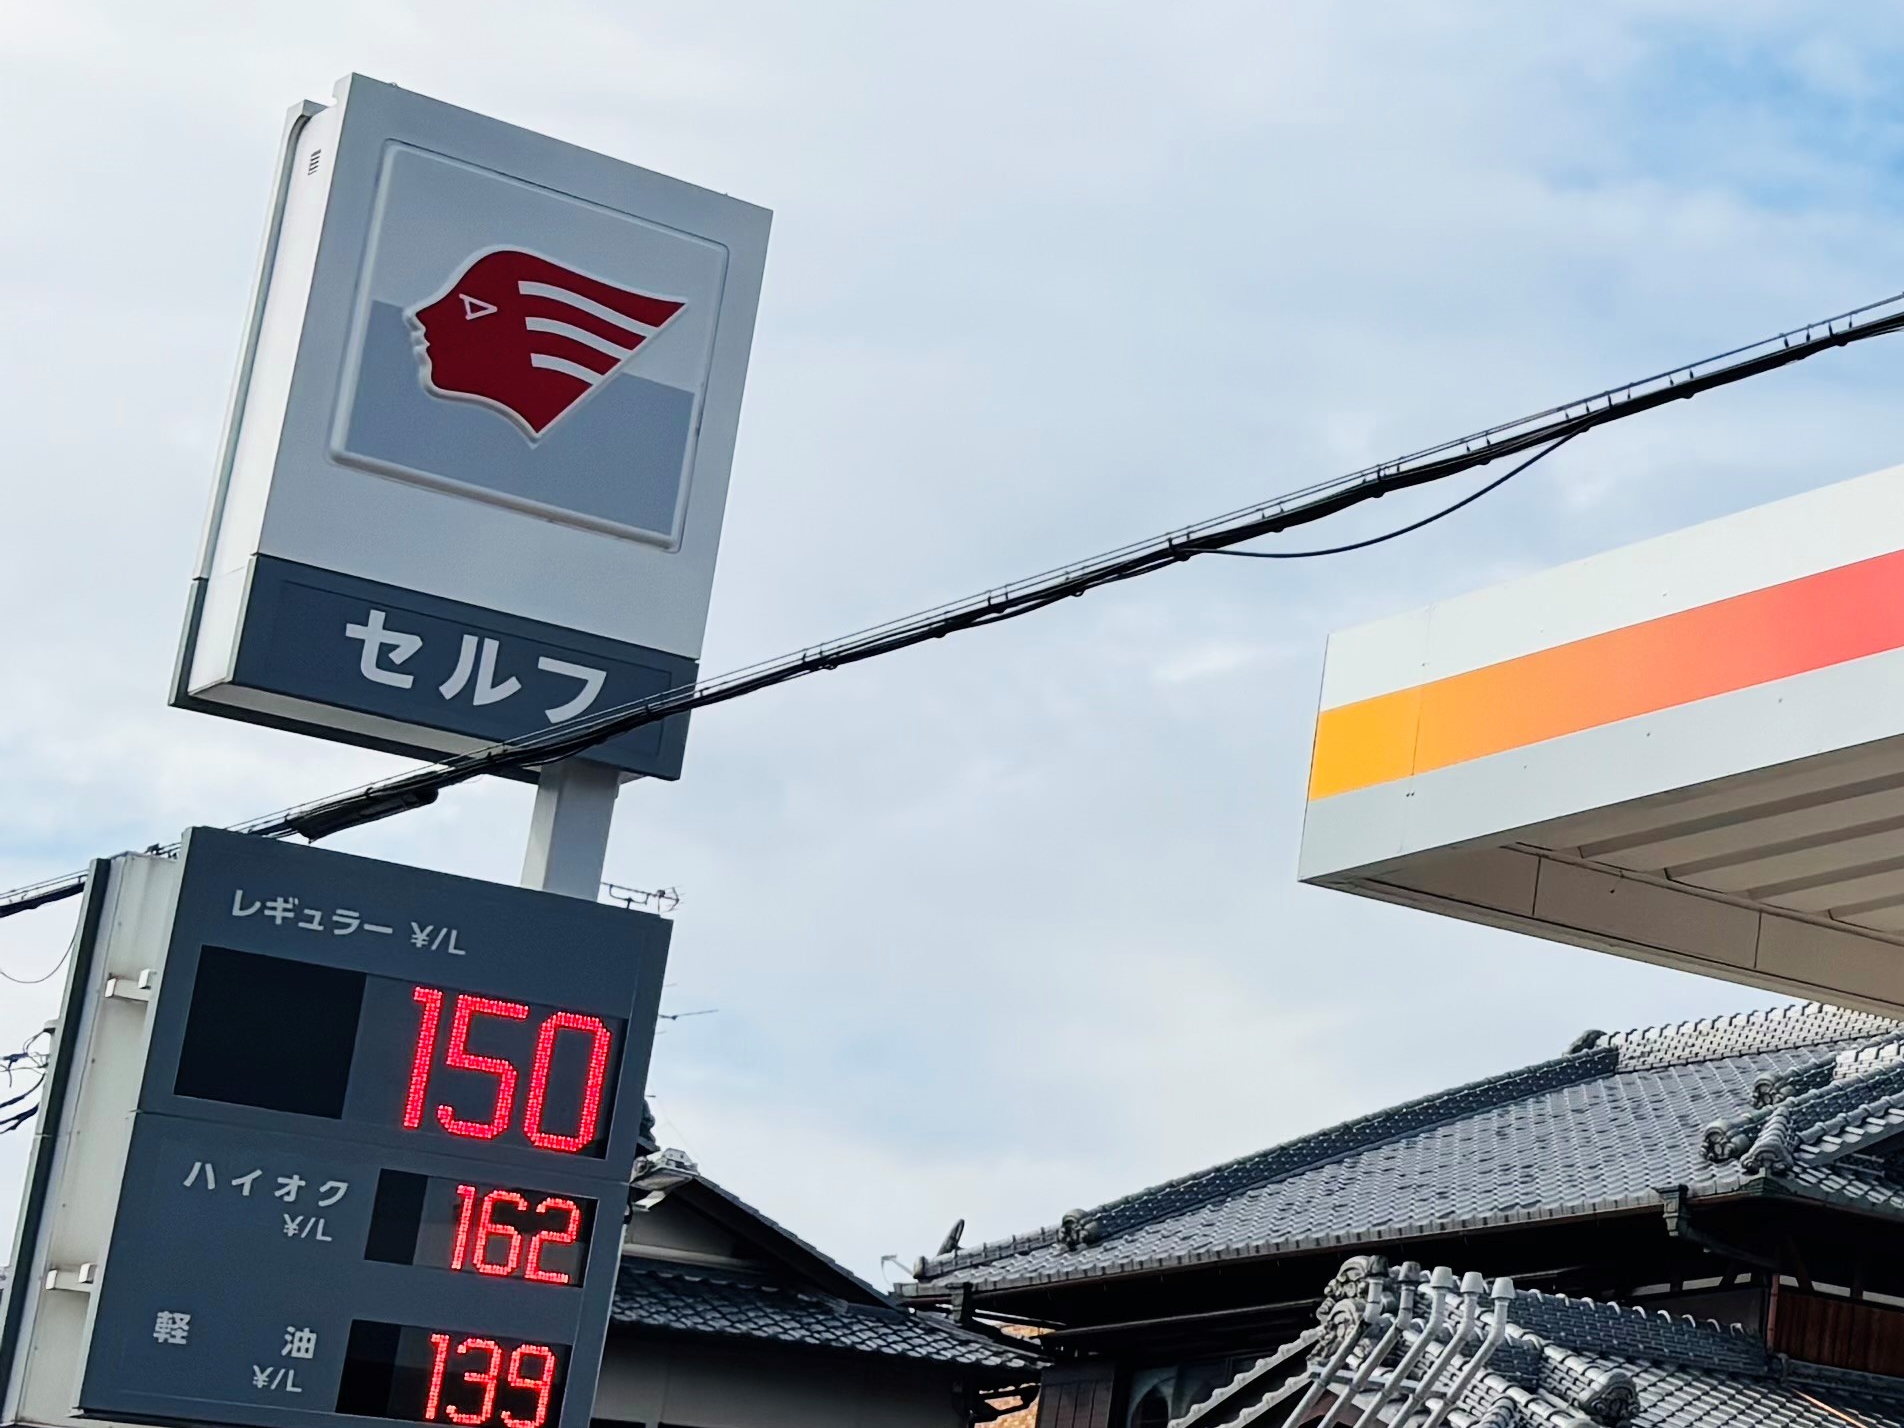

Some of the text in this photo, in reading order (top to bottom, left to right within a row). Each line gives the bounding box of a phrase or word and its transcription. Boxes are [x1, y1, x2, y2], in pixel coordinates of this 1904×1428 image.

[345, 609, 607, 724] セルフ
[232, 889, 466, 955] レギュラー ¥/L
[404, 985, 612, 1152] 150
[184, 1161, 349, 1208] ハイオク
[283, 1214, 333, 1242] ¥/L
[452, 1184, 581, 1283] 162
[252, 1364, 303, 1393] ¥/L
